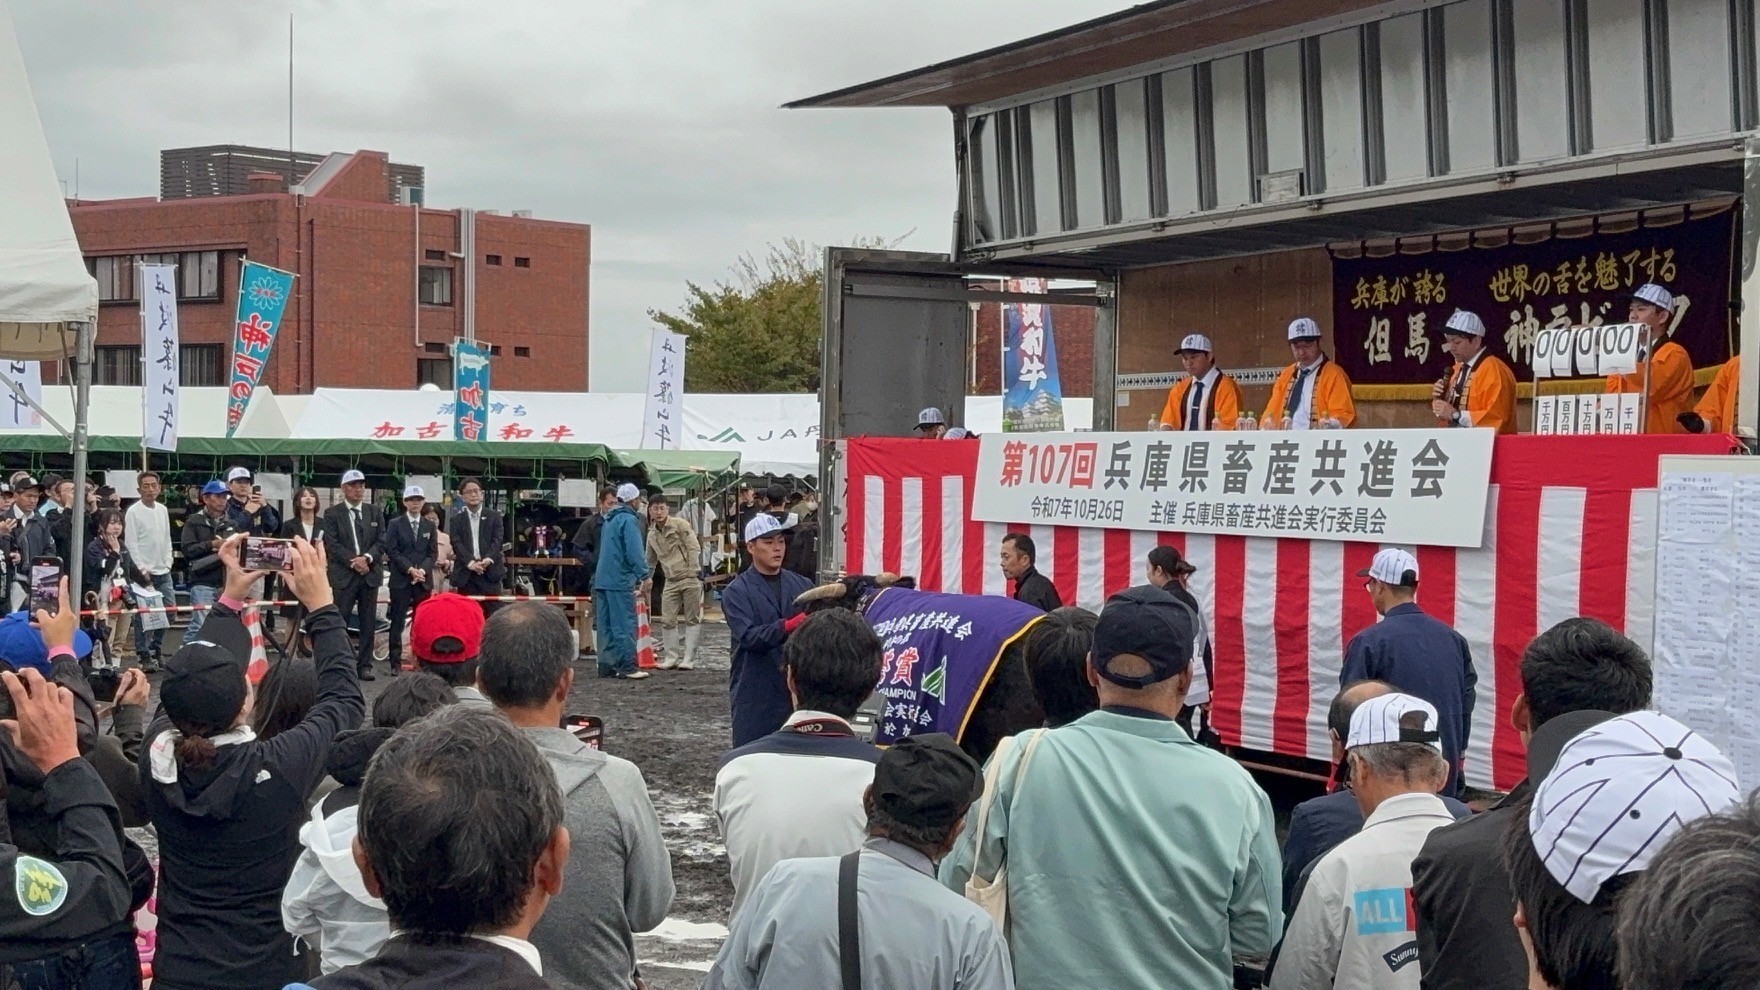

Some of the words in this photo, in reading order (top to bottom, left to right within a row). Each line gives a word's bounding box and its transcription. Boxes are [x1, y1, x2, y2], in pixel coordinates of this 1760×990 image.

[1489, 247, 1676, 303] 世界の舌を魅了する
[1364, 308, 1452, 366] 但馬
[371, 421, 575, 442] 加古和牛
[1030, 495, 1124, 523] 令和7年10月26日
[1149, 500, 1178, 525] 主催
[1181, 501, 1388, 534] 兵庫県畜産共進会実行委員会
[1362, 898, 1403, 925] ALL
[1390, 946, 1419, 966] Sunny
